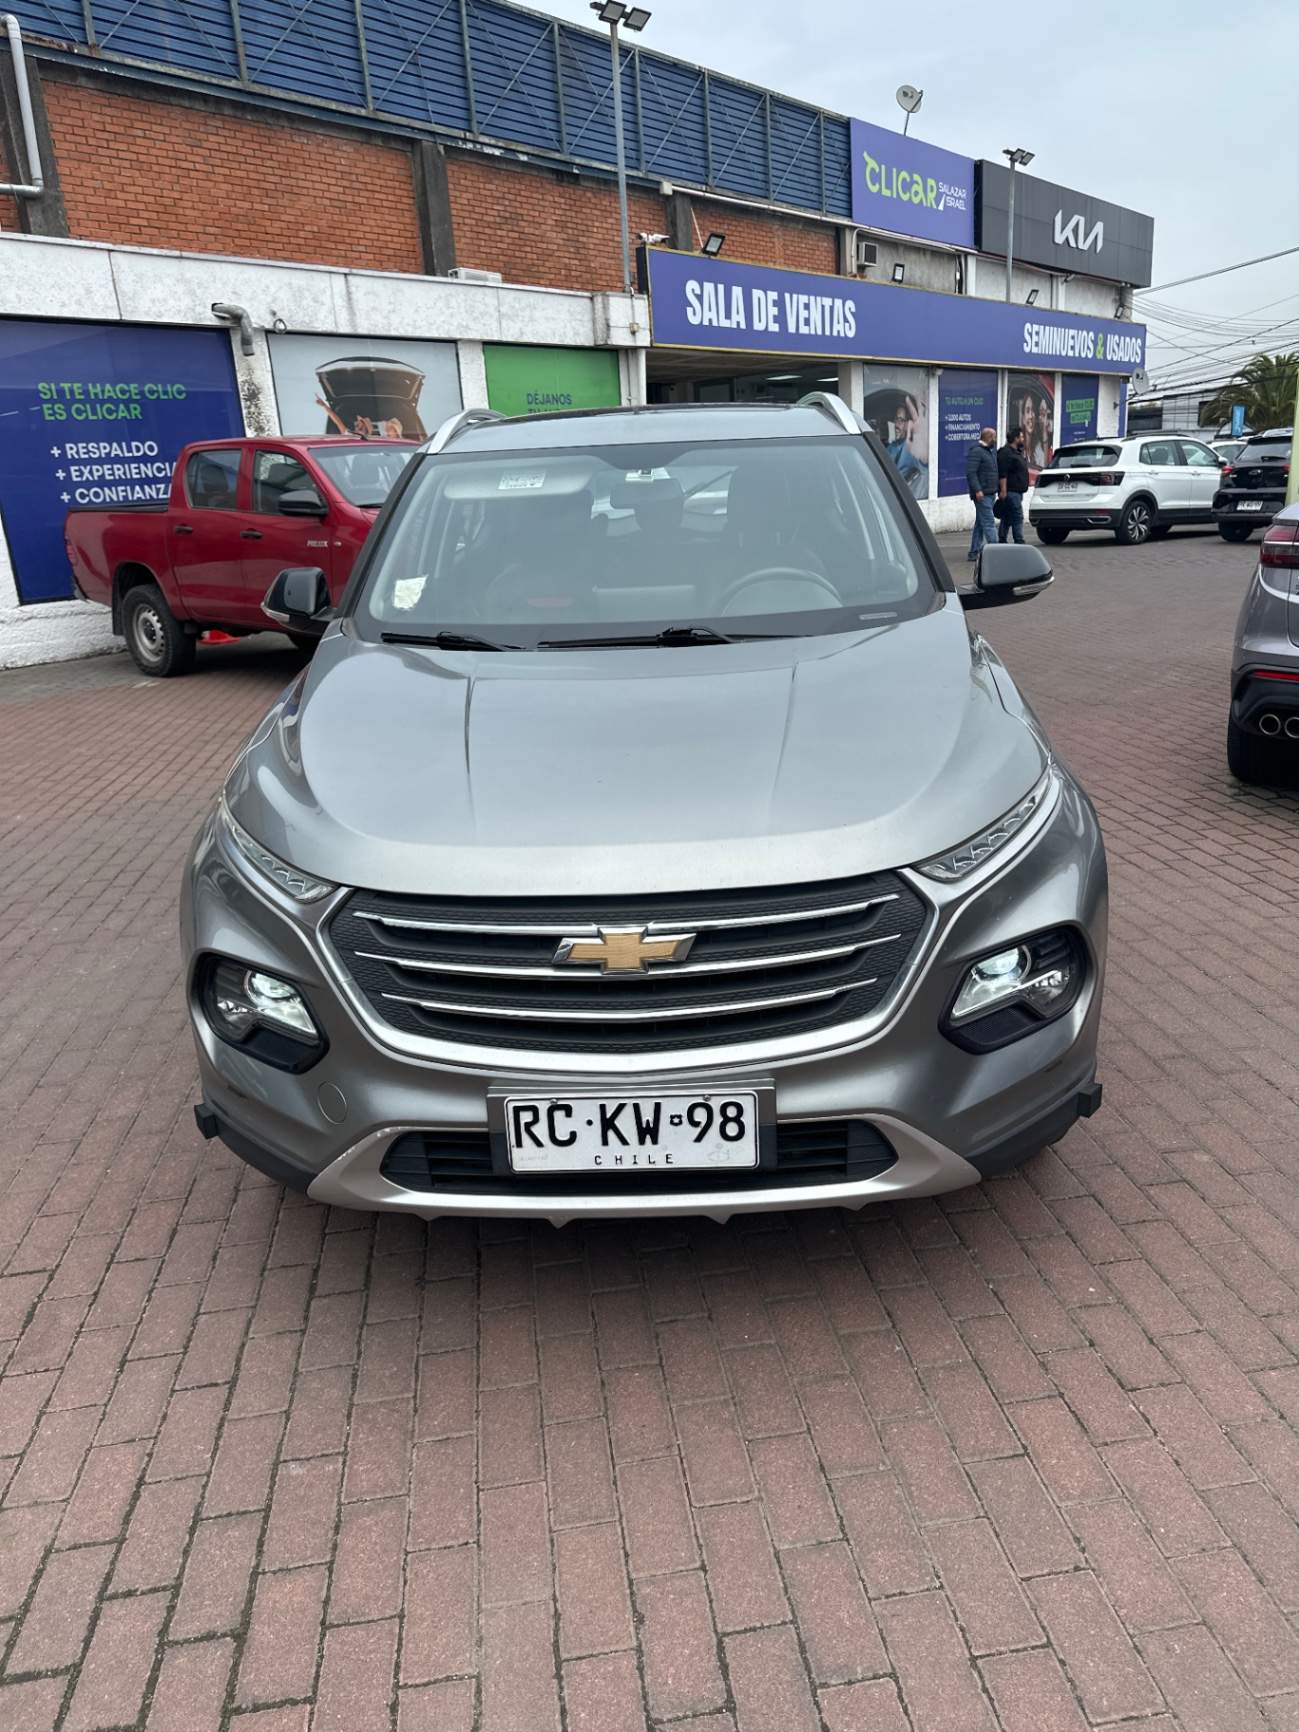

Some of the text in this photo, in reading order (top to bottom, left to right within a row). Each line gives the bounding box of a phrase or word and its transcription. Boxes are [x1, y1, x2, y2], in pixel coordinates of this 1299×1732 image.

[938, 182, 966, 199] SALAZAR
[685, 279, 856, 338] SALA DE VENTAS
[1023, 322, 1142, 363] SEMINUEVOS & USADOS
[38, 382, 187, 400] SI TE HACE CLIC
[526, 389, 573, 405] DÉJANOS
[42, 403, 143, 421] ES CLICAR
[65, 441, 158, 459] RESPALDO
[594, 1153, 674, 1166] CHILE
